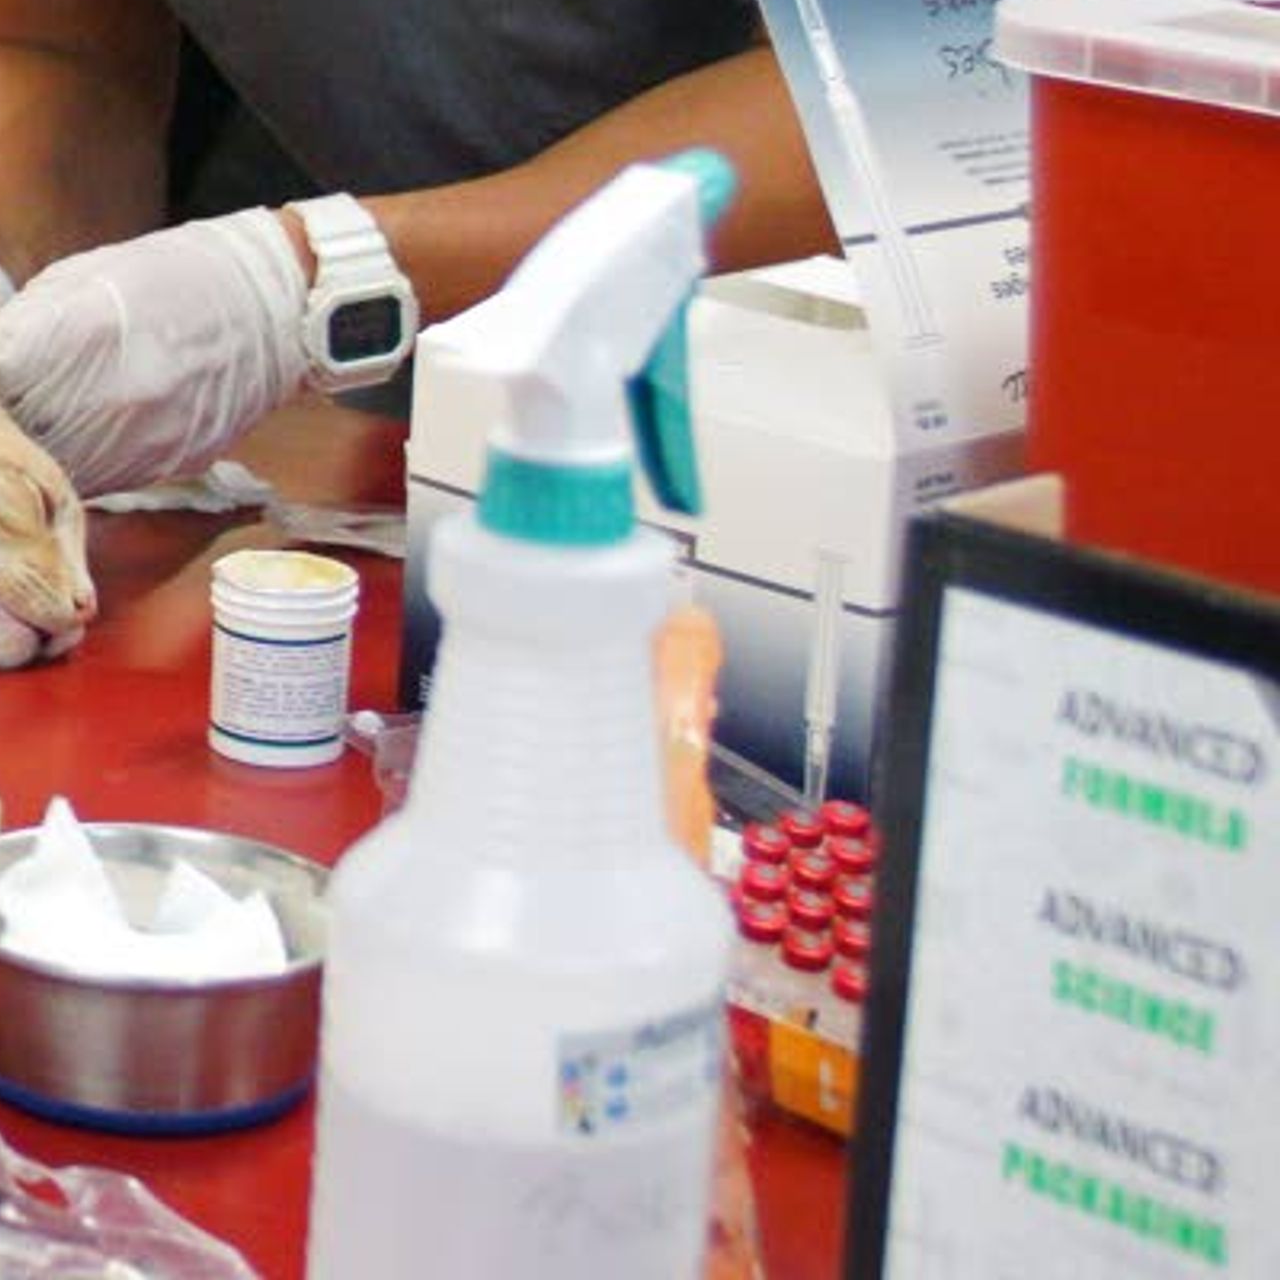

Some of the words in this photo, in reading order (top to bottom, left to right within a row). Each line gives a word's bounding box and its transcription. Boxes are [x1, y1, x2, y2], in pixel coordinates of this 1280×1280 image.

[1056, 688, 1265, 786] ADVANCED
[1061, 756, 1247, 851] FORMULA
[1040, 886, 1248, 991] ADVANCED
[1051, 957, 1216, 1056] SCIENCE
[1019, 1086, 1229, 1194] ADVANCED
[1002, 1140, 1229, 1266] PACKAGING
